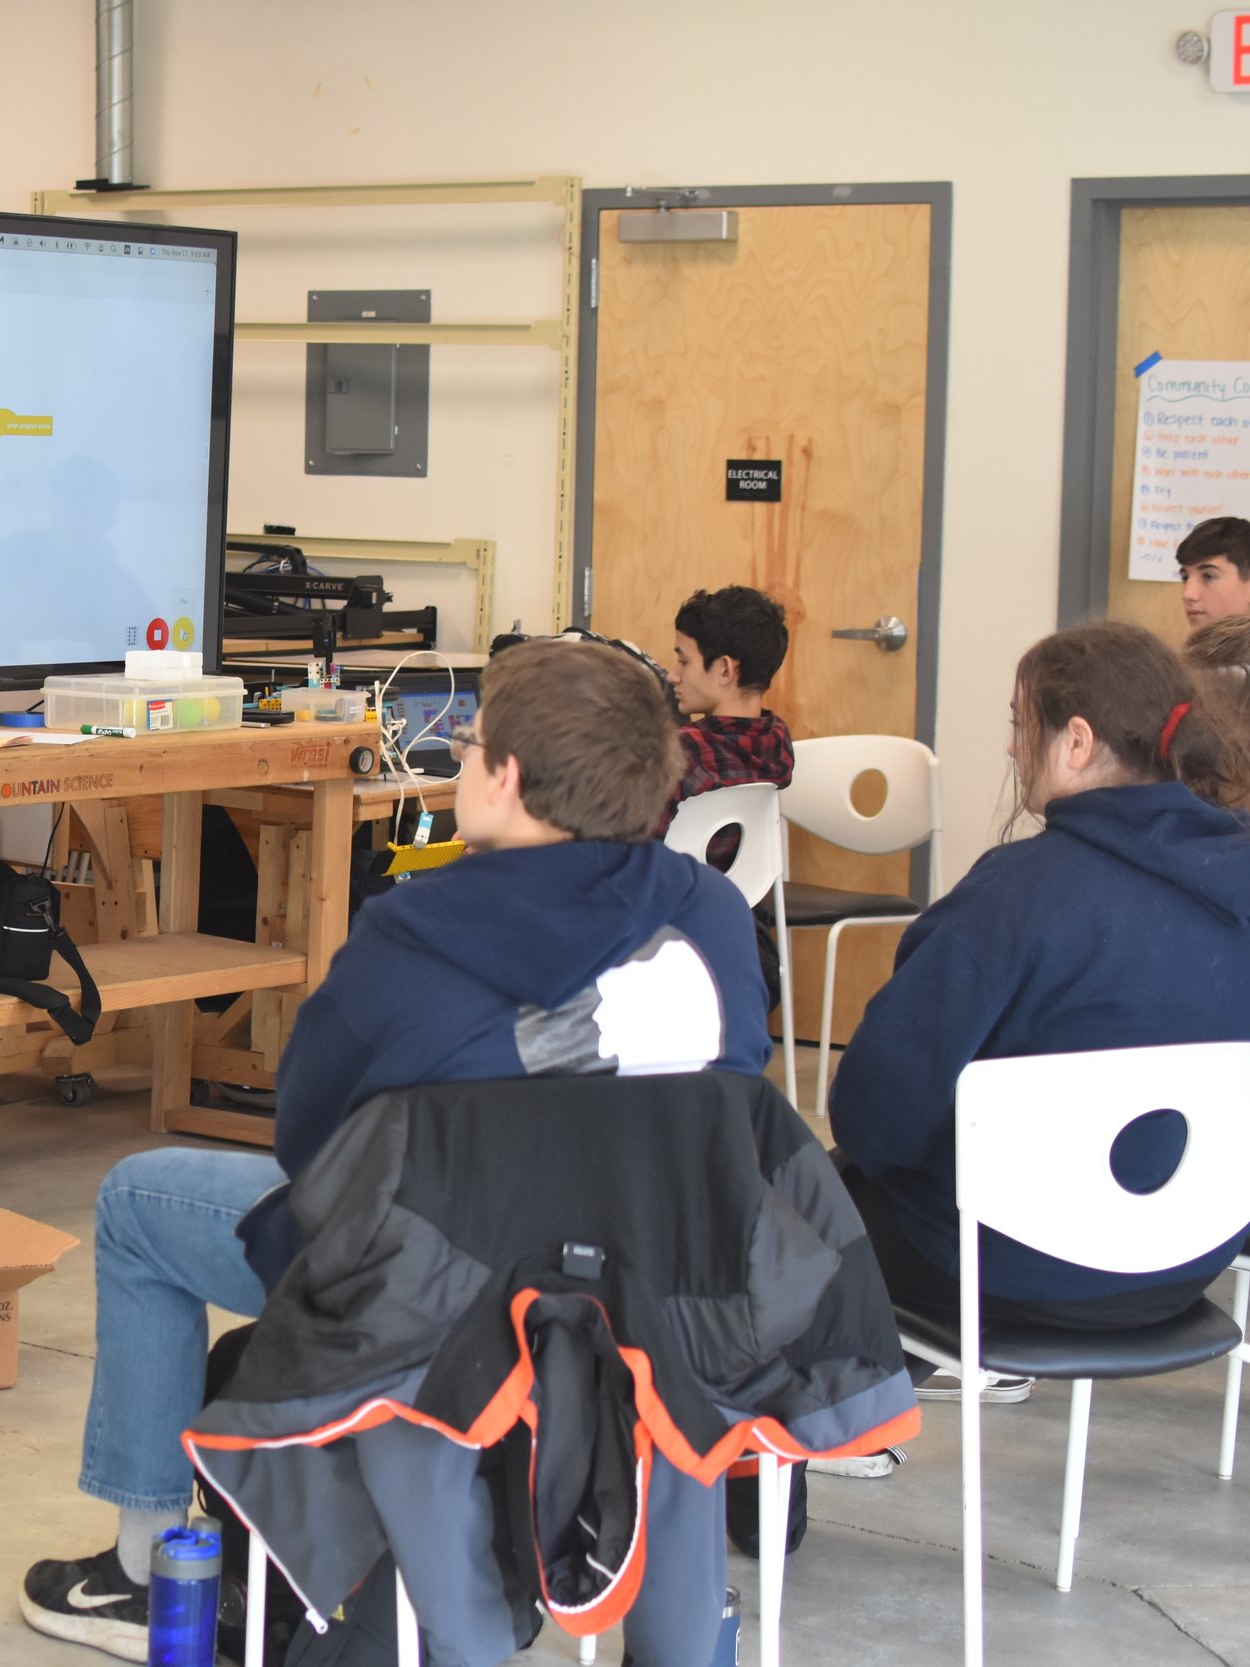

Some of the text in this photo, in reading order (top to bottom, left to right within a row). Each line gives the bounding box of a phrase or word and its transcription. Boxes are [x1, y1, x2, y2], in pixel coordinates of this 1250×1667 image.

[1233, 15, 1250, 86] E
[1148, 375, 1226, 400] Community
[1157, 412, 1203, 429] Respect
[1211, 416, 1237, 427] each
[1156, 448, 1208, 461] Be patient
[728, 469, 778, 480] ELECTRICAL
[739, 480, 767, 490] ROOM
[1154, 485, 1171, 499] Try
[63, 773, 114, 793] SCIENCE
